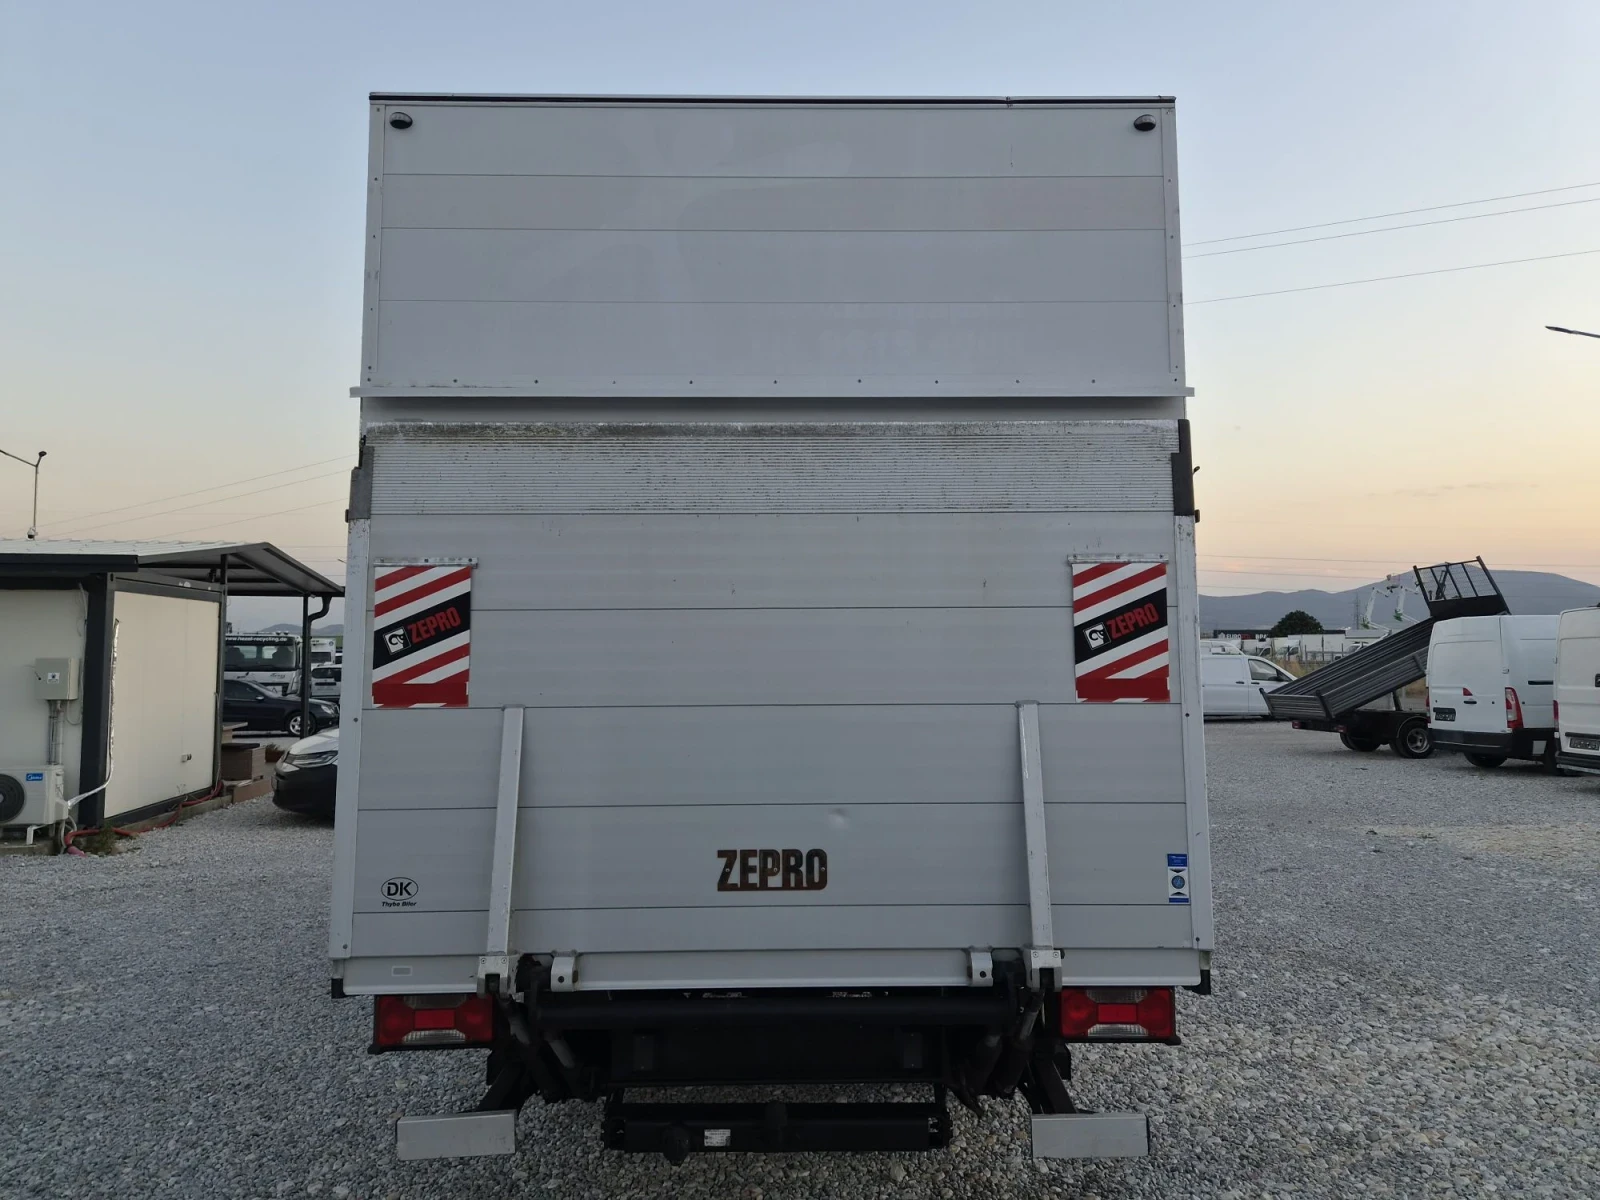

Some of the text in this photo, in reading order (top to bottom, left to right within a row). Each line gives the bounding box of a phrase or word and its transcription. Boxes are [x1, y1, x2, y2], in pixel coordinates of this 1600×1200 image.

[407, 606, 461, 644] ZEPRO
[1106, 603, 1159, 640] ZEPRO
[387, 881, 412, 896] DK
[717, 848, 828, 892] ZEPRO
